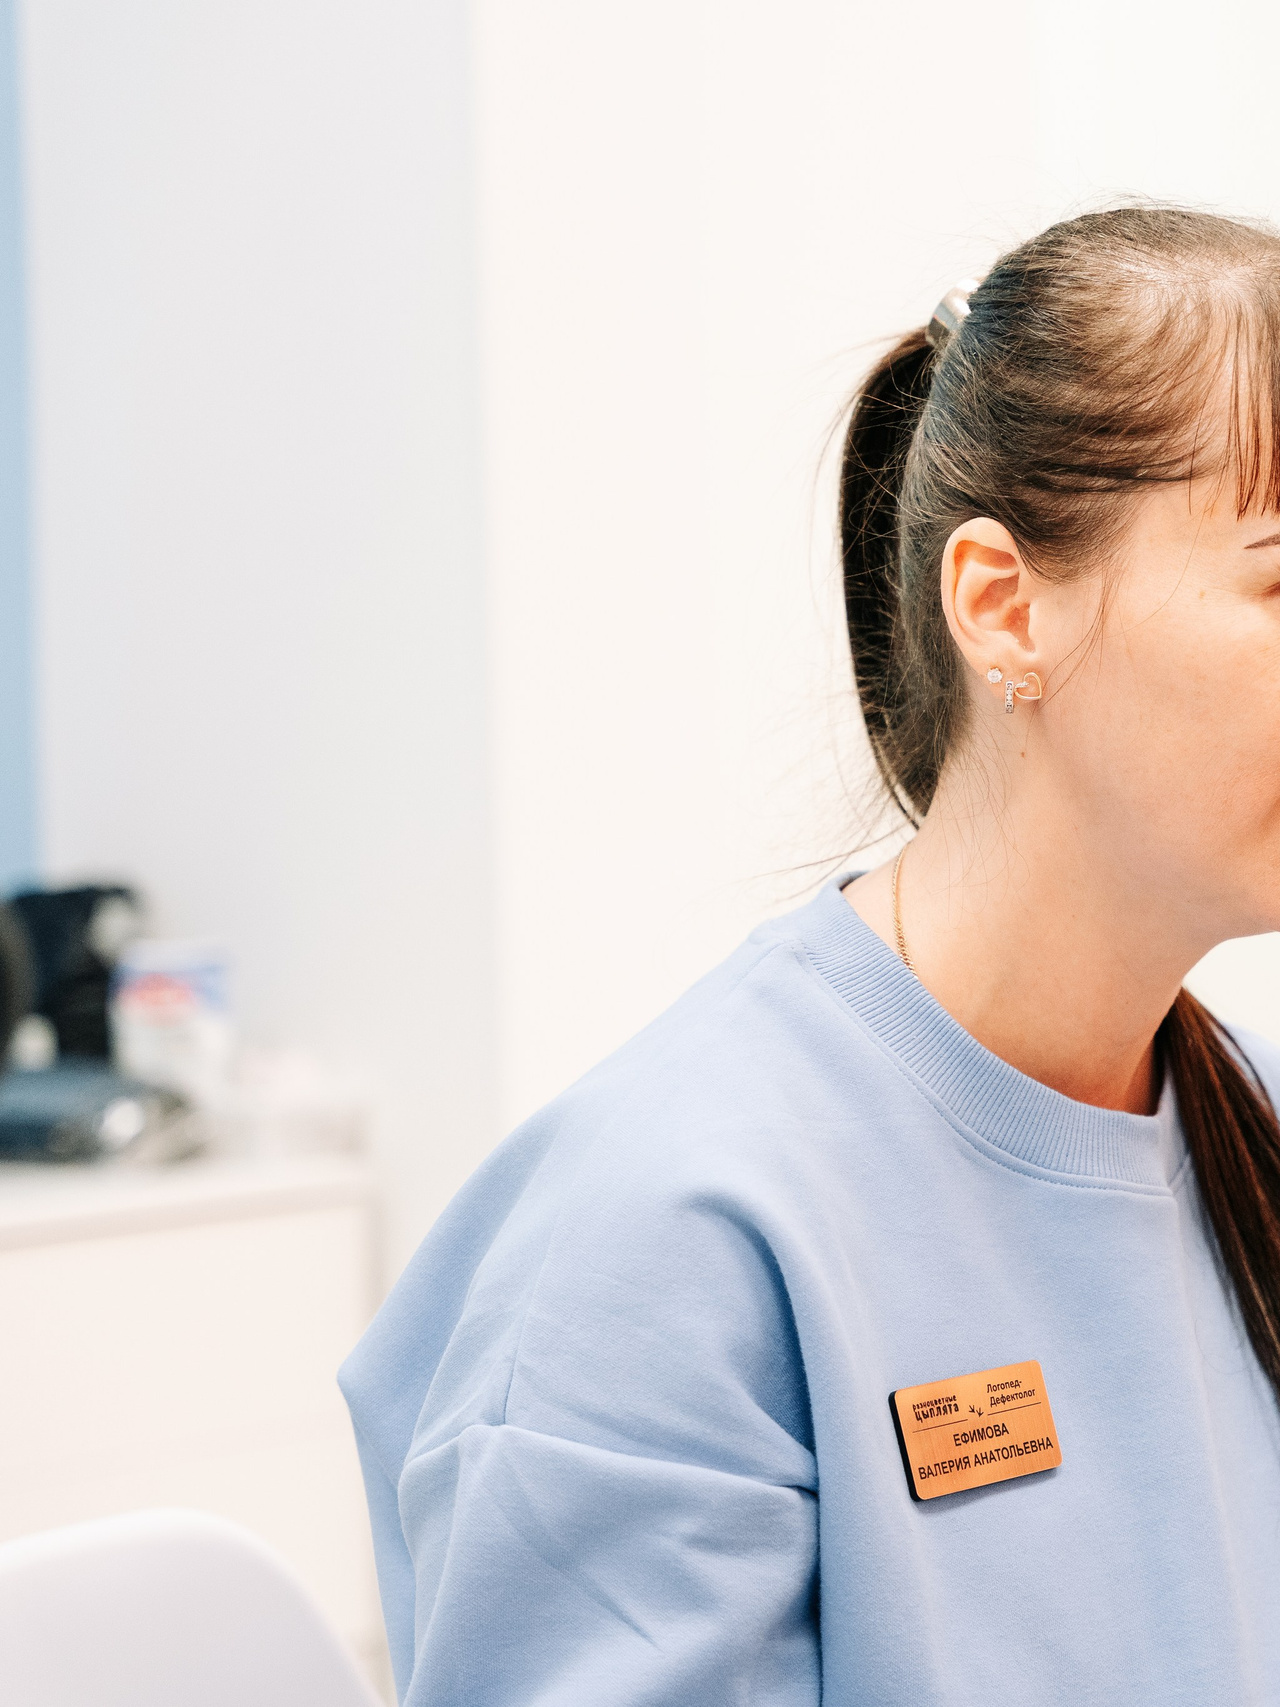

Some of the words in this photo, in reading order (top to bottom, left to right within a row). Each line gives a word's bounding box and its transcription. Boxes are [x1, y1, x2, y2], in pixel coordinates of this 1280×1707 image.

[986, 1379, 1022, 1393] Логопед-
[912, 1394, 957, 1413] разноцветные
[989, 1388, 1036, 1408] Дефектолог
[953, 1422, 1010, 1447] ЕФИМОВА
[918, 1456, 971, 1480] ВАЛЕРИЯ
[973, 1436, 1054, 1468] АНАТОЛЬЕВНА
